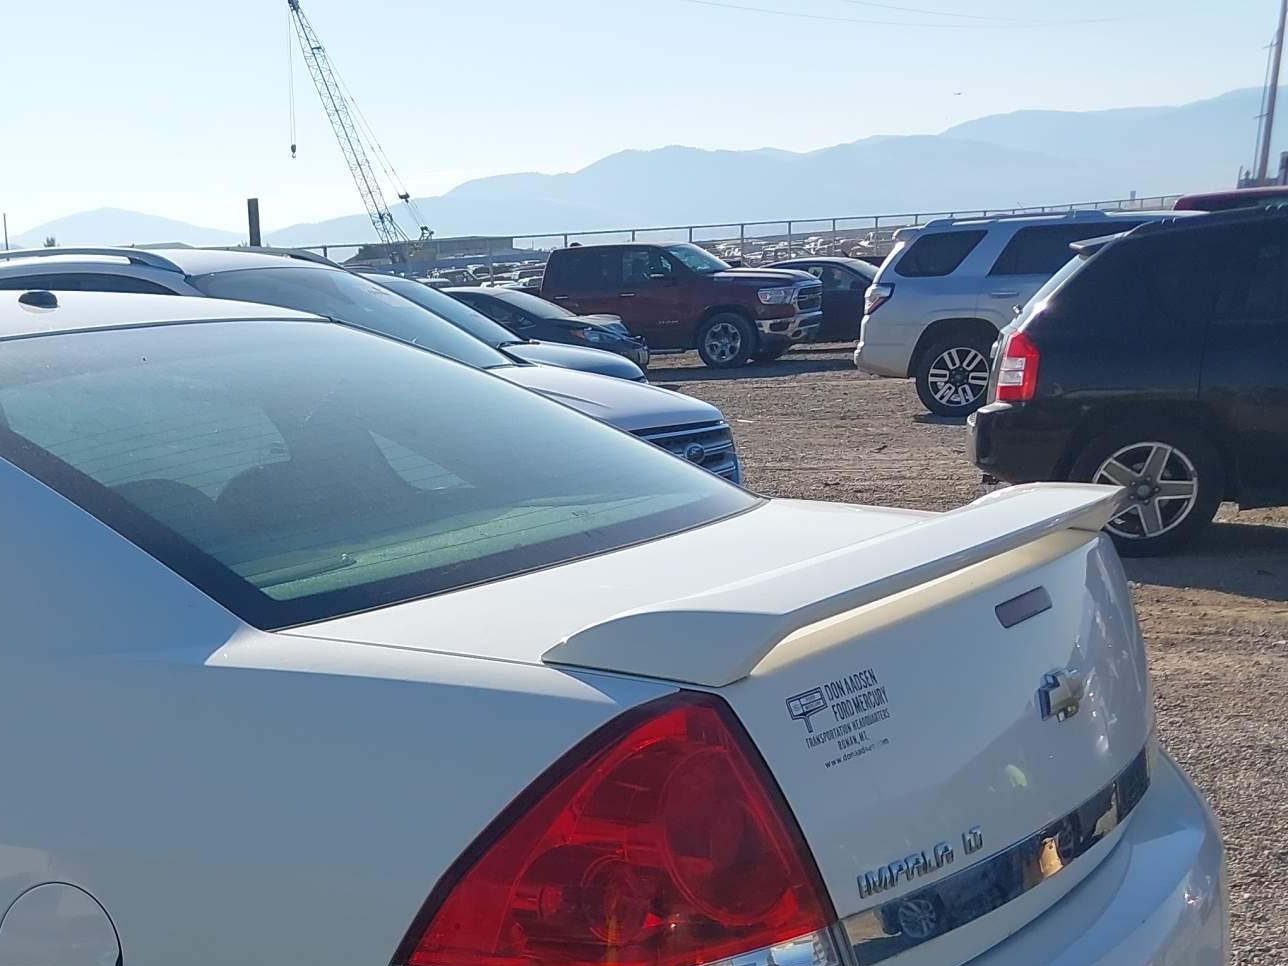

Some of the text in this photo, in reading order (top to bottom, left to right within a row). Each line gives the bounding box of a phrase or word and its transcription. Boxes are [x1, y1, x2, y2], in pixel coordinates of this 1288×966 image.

[824, 668, 878, 701] DON AADSEN
[832, 699, 855, 722] FORD
[851, 686, 889, 714] MERCURY
[805, 723, 852, 749] TRANSPORTATION
[856, 841, 954, 899] IMPALA
